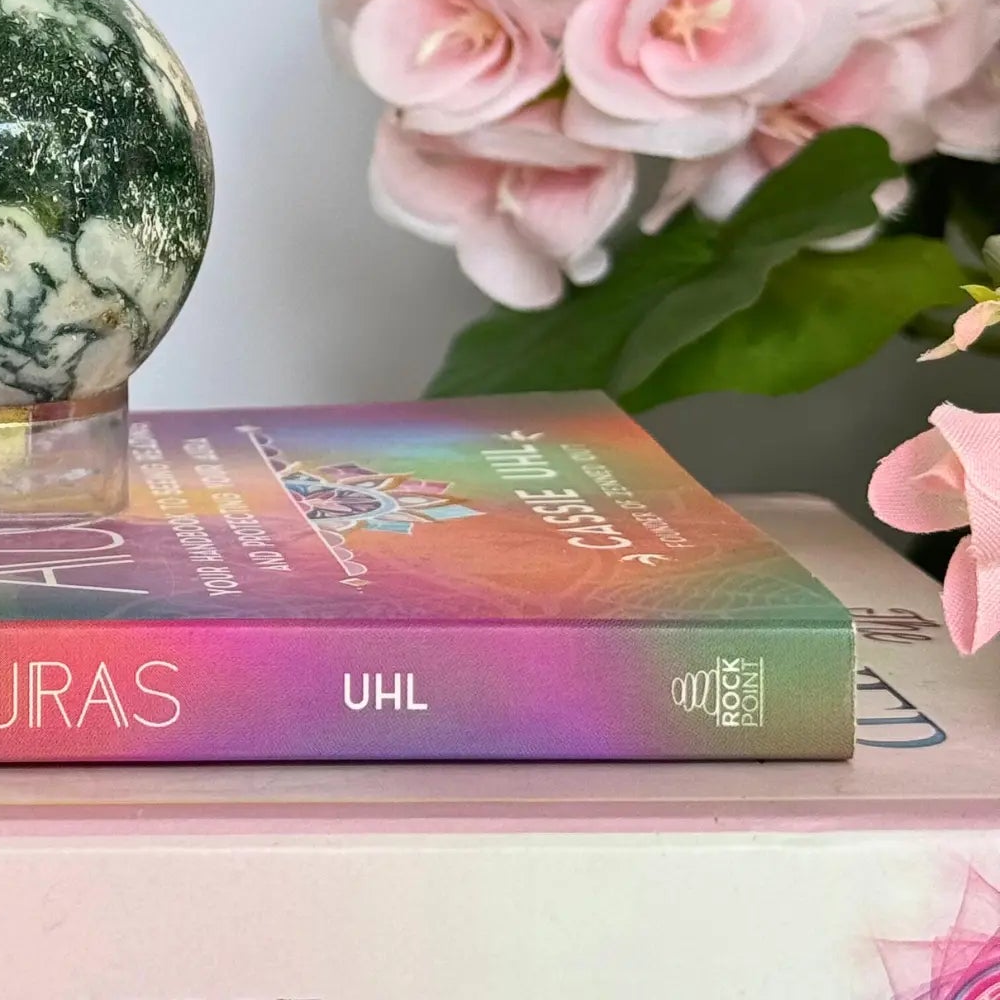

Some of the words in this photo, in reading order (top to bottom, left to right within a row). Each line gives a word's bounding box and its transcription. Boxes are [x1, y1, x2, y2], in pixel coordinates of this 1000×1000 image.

[480, 443, 558, 480] UHL
[166, 512, 225, 563] HANDBOOK
[211, 492, 276, 548] PROTECTING
[514, 487, 633, 550] CASSIE
[196, 566, 242, 597] YOUR
[248, 550, 292, 573] AND
[342, 672, 429, 711] UHL
[721, 657, 741, 727] ROCK
[741, 658, 759, 727] POINT
